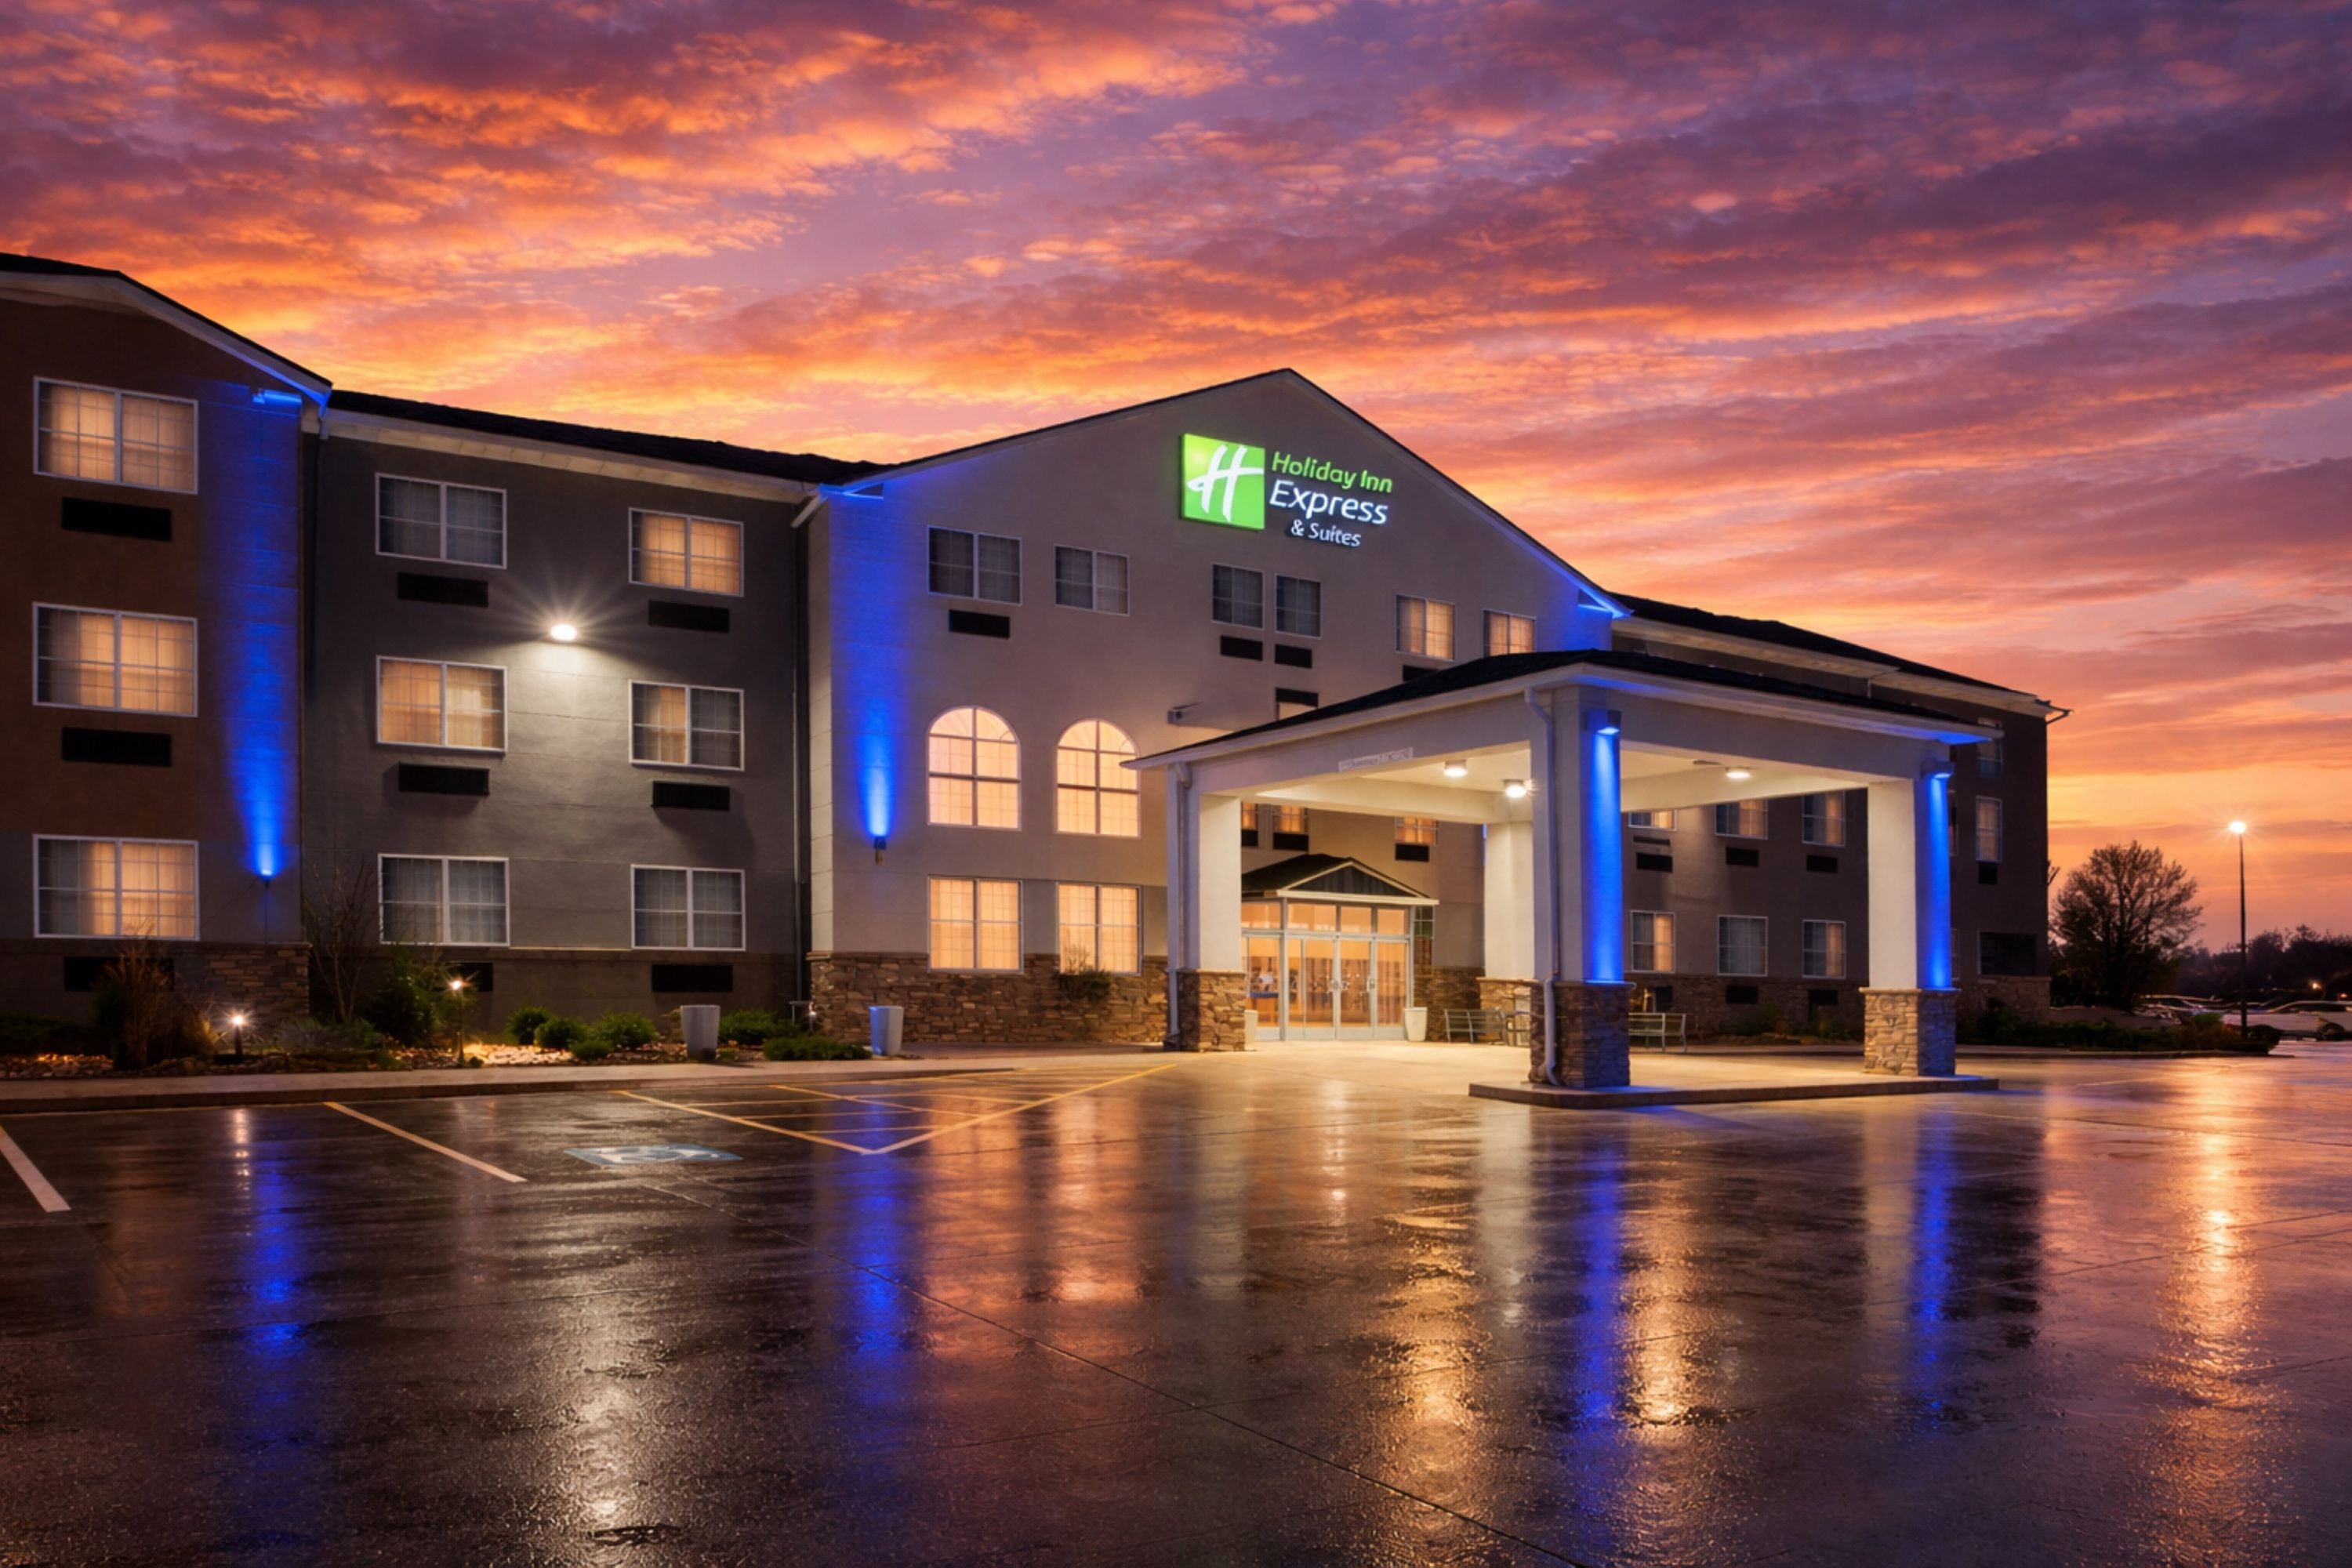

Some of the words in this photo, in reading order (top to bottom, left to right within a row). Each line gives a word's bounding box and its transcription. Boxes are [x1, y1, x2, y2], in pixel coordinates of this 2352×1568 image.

[1186, 444, 1264, 523] H
[1272, 451, 1356, 490] Holiday
[1359, 470, 1392, 493] Inn
[1269, 480, 1388, 524] Express
[1290, 520, 1305, 536] &
[1308, 523, 1361, 547] Suites
